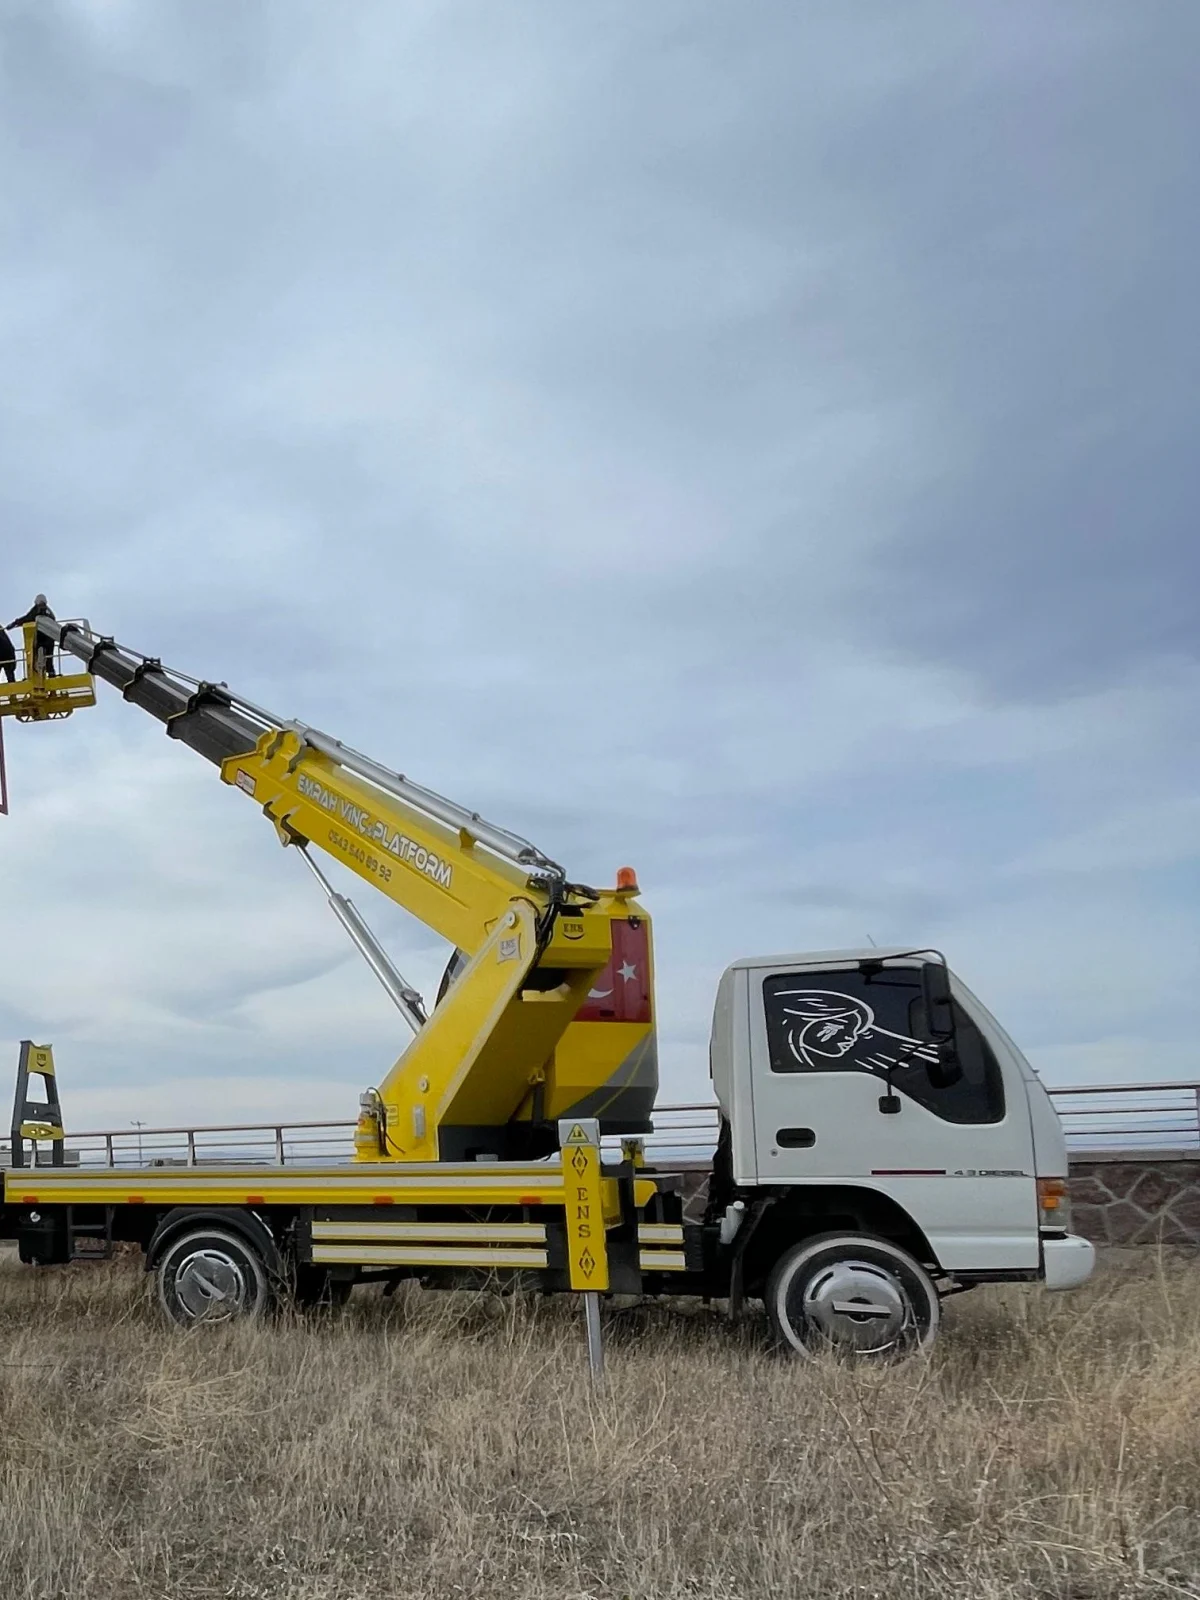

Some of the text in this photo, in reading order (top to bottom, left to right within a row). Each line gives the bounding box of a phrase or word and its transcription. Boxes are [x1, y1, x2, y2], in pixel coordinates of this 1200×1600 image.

[296, 773, 338, 813] EMRAH
[373, 820, 454, 890] PLATFORM
[378, 864, 392, 882] 92
[576, 1187, 592, 1239] ENS
